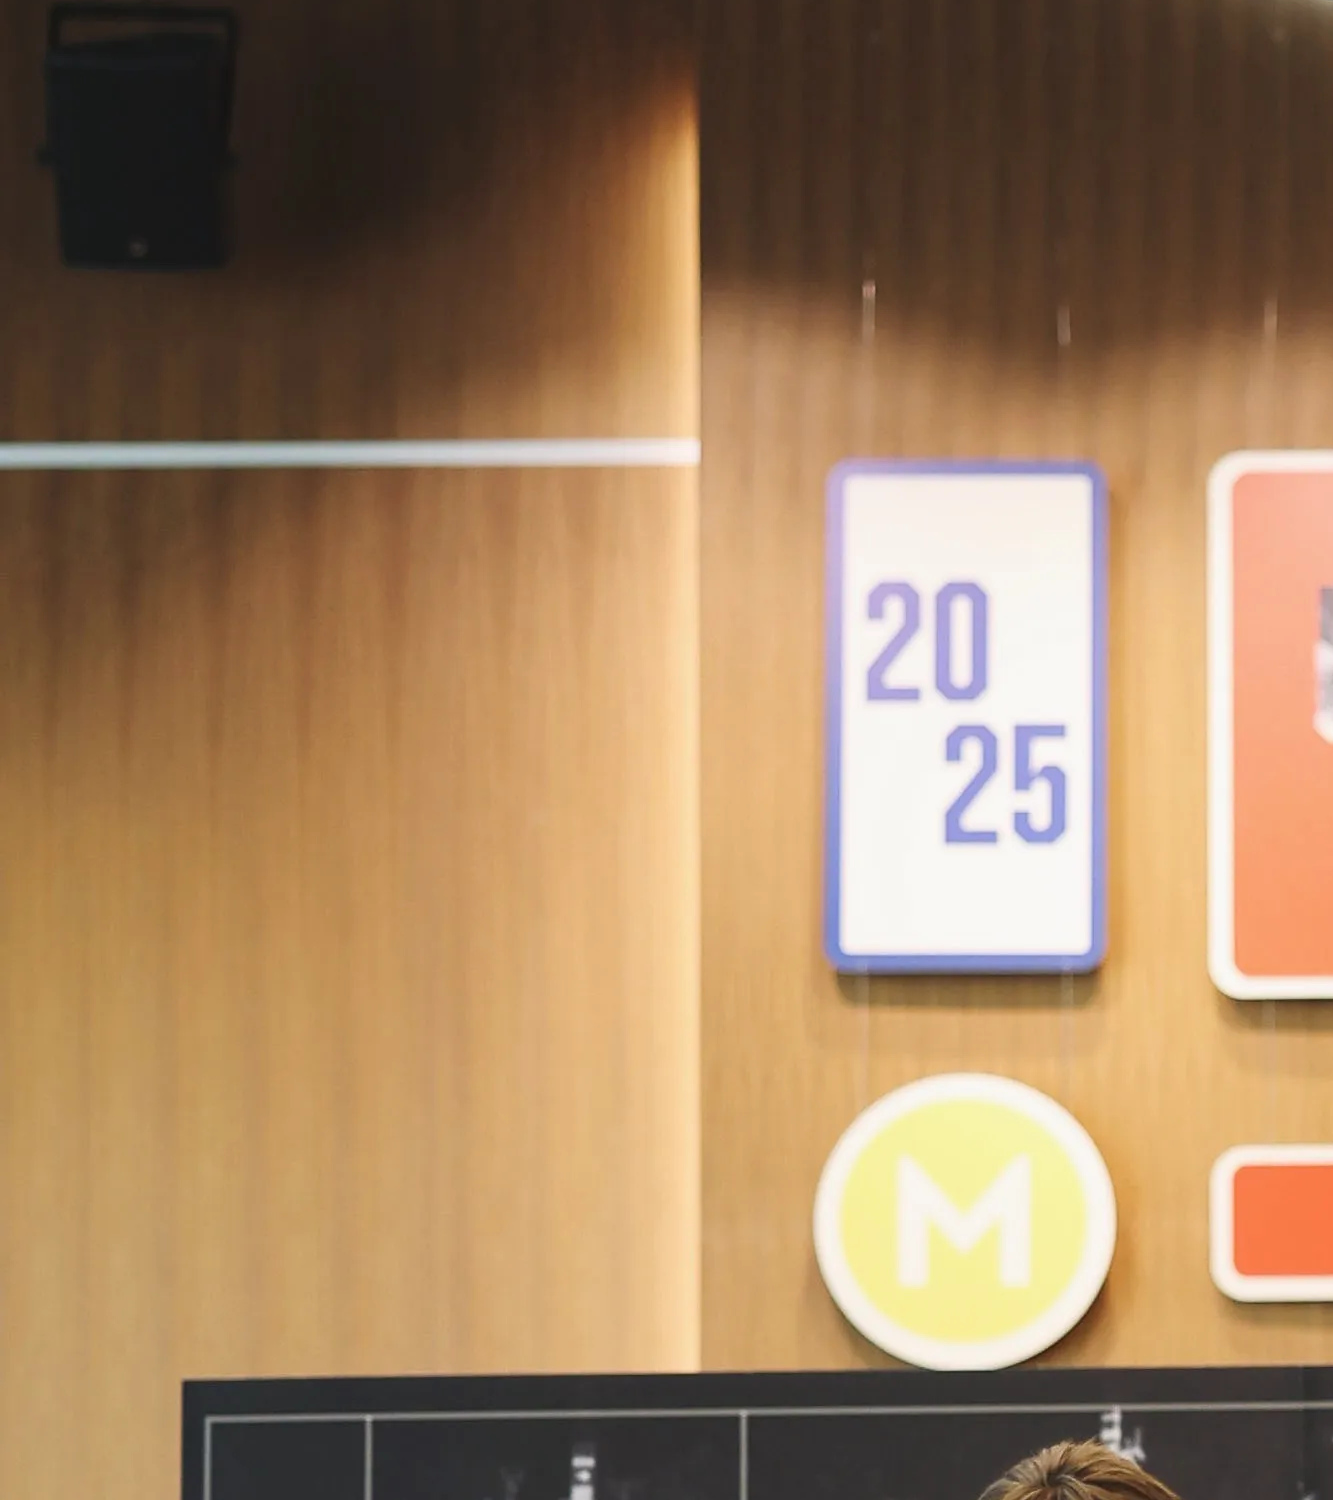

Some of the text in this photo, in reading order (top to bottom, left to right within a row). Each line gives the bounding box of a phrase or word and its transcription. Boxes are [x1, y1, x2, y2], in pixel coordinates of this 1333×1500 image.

[867, 582, 989, 700] 20
[944, 724, 1067, 843] 25
[897, 1150, 1031, 1288] M
